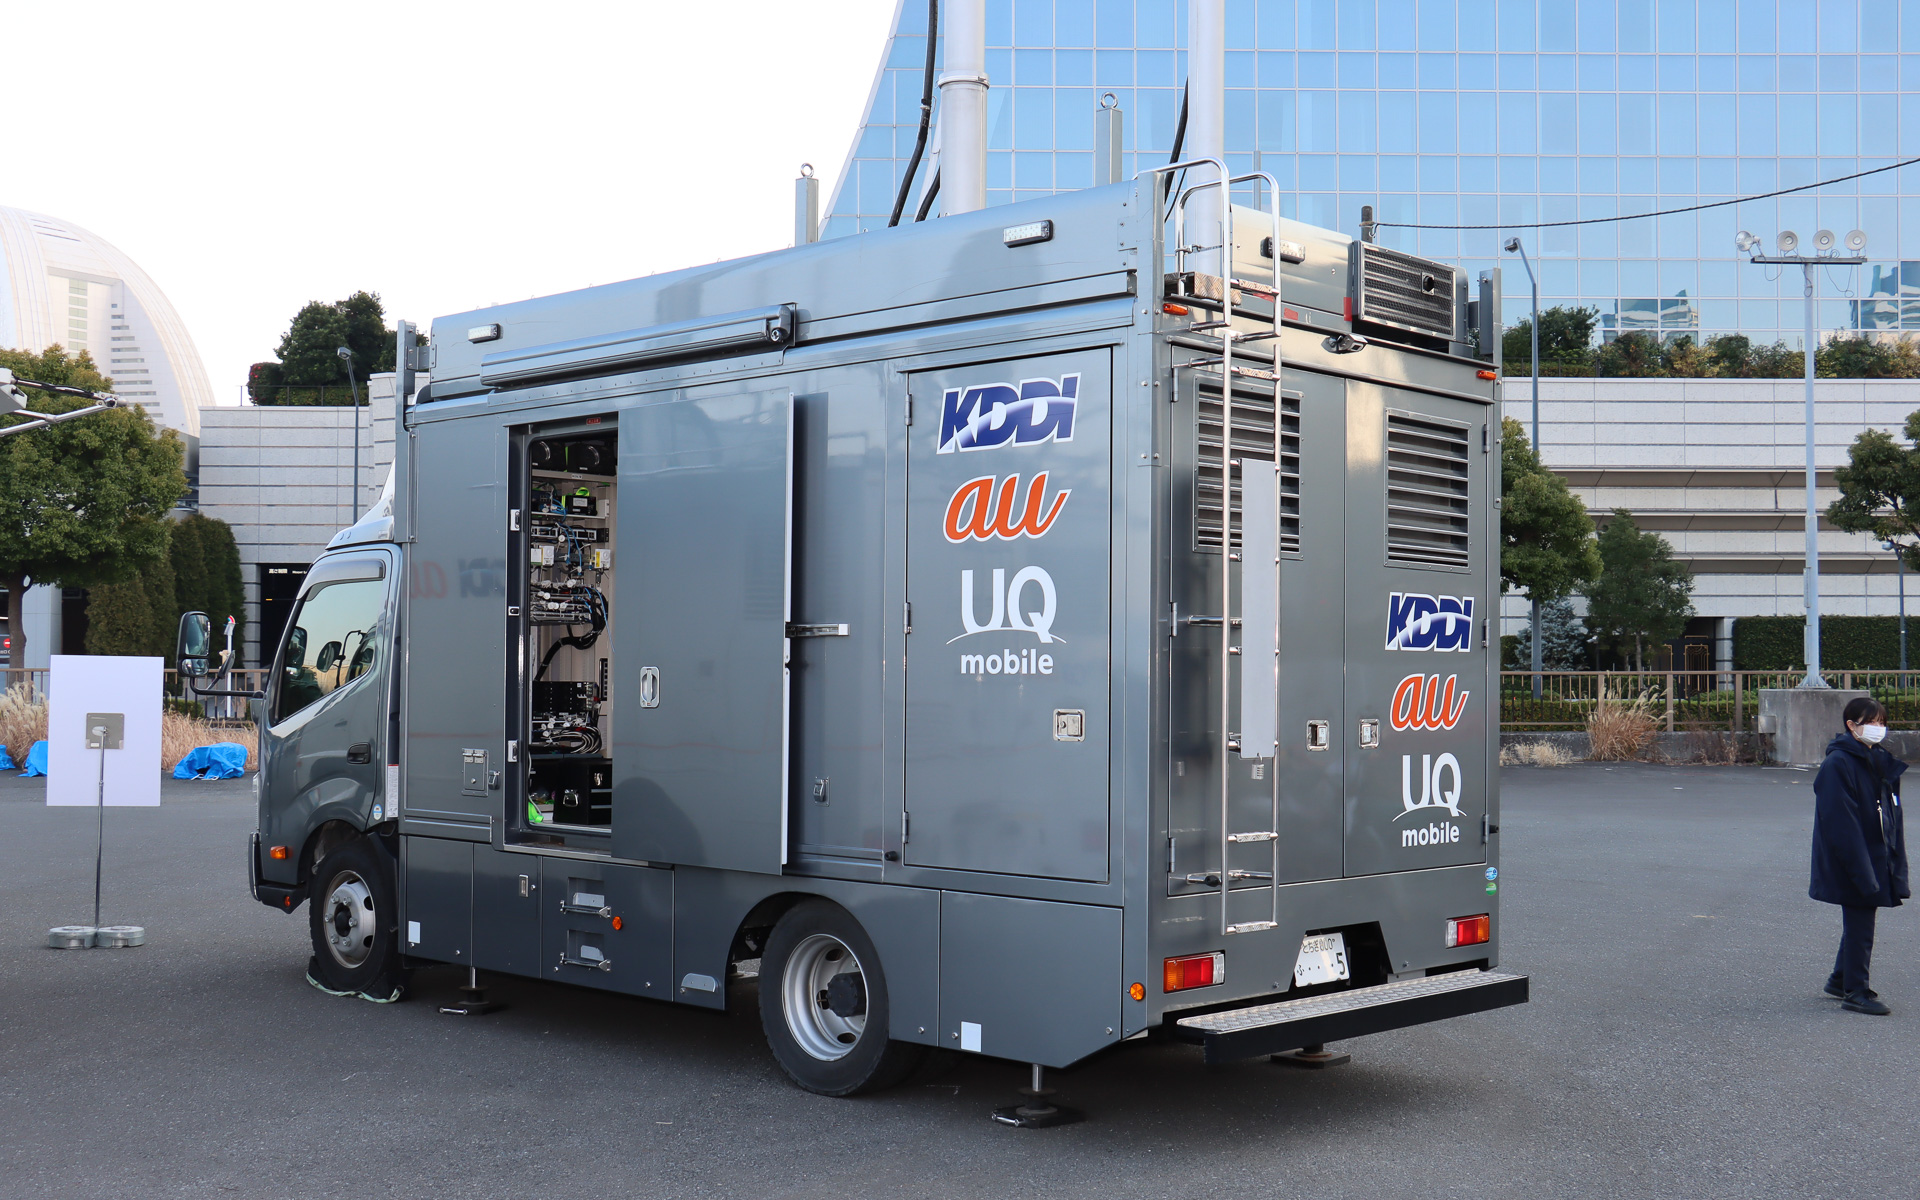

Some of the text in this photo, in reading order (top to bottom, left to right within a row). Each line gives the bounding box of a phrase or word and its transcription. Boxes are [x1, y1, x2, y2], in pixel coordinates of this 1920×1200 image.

[937, 372, 1082, 455] KDDI
[943, 470, 1072, 544] au
[961, 565, 1058, 643] UQ
[1384, 592, 1475, 653] KDDI
[960, 649, 1054, 675] mobile
[1389, 673, 1470, 732] au
[1402, 752, 1462, 817] UQ
[1401, 821, 1460, 848] mobile
